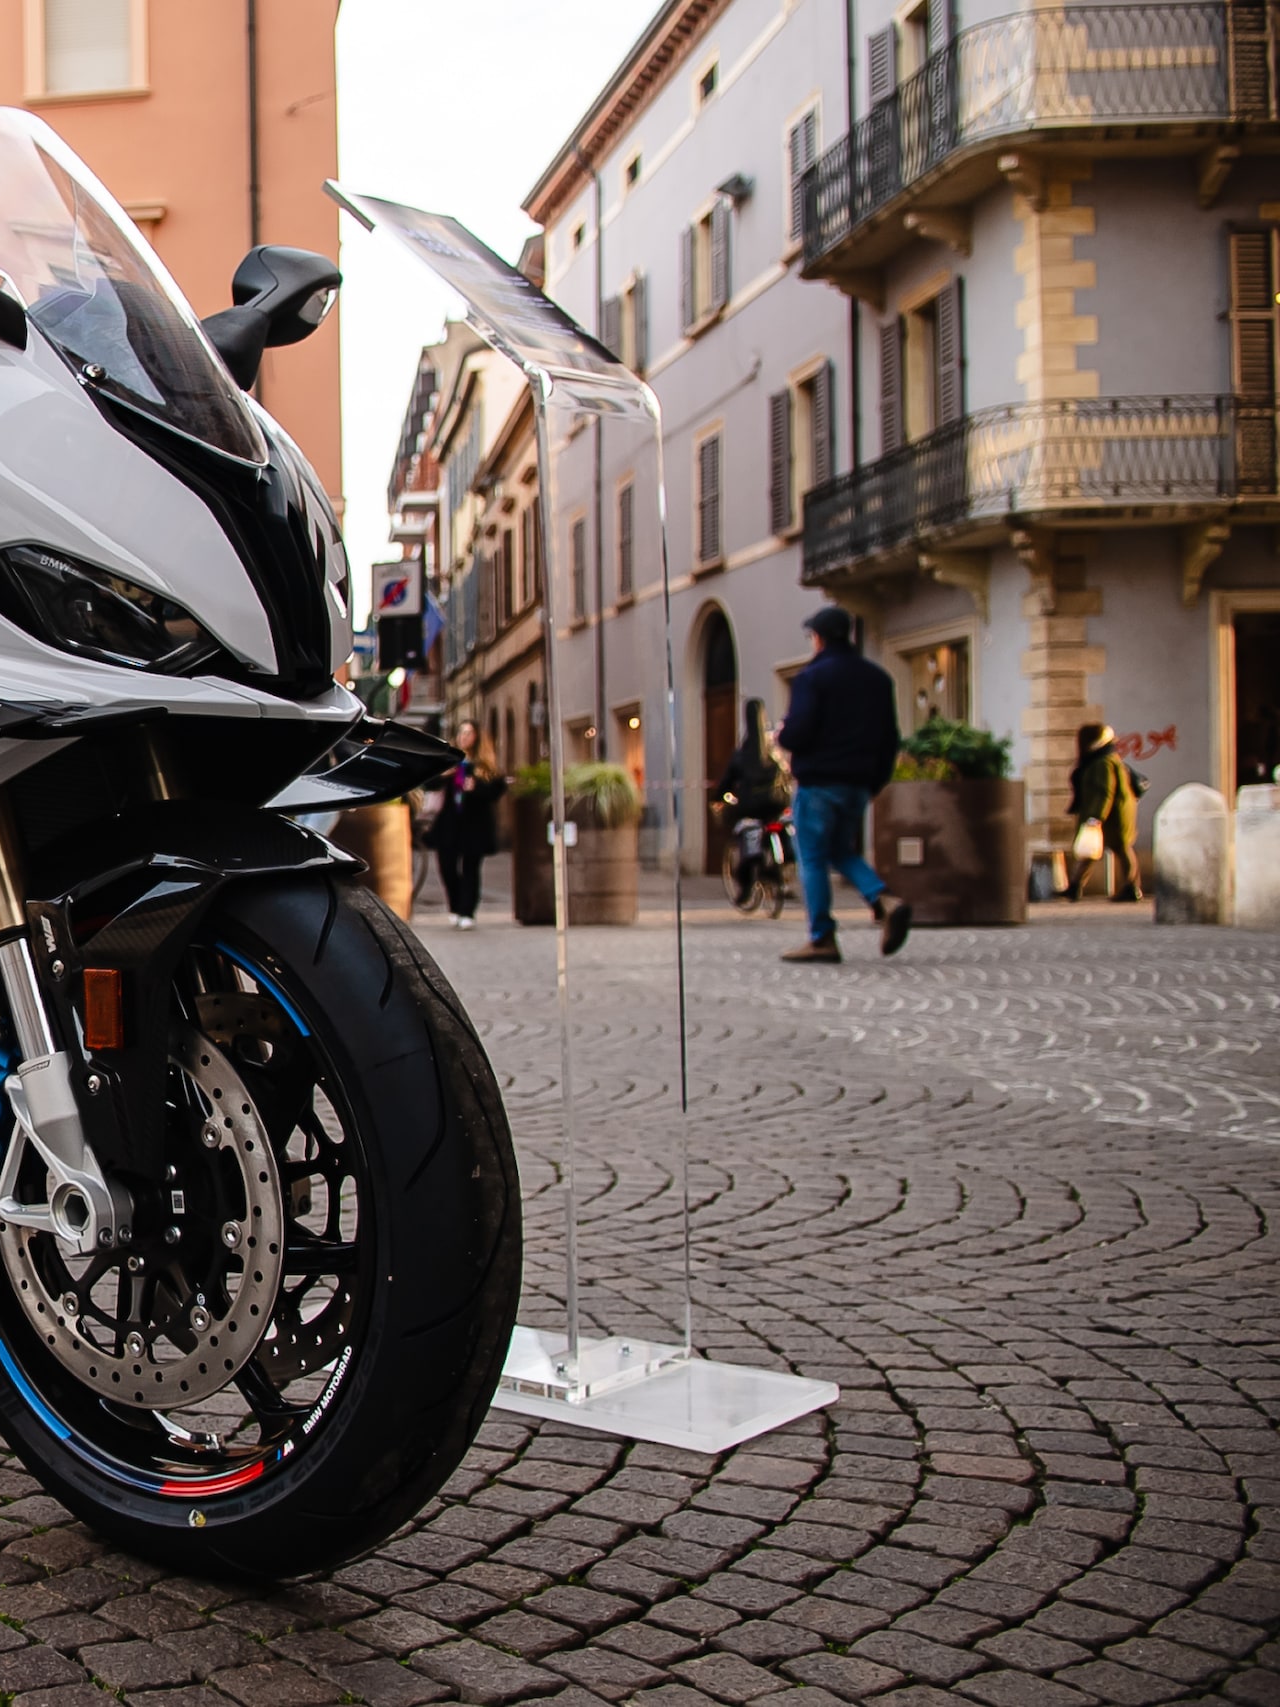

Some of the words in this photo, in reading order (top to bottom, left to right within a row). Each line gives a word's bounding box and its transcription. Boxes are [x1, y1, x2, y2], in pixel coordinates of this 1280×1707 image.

[40, 554, 69, 572] BMW
[302, 1406, 323, 1434] BMW
[320, 1345, 353, 1410] MOTORRAD
